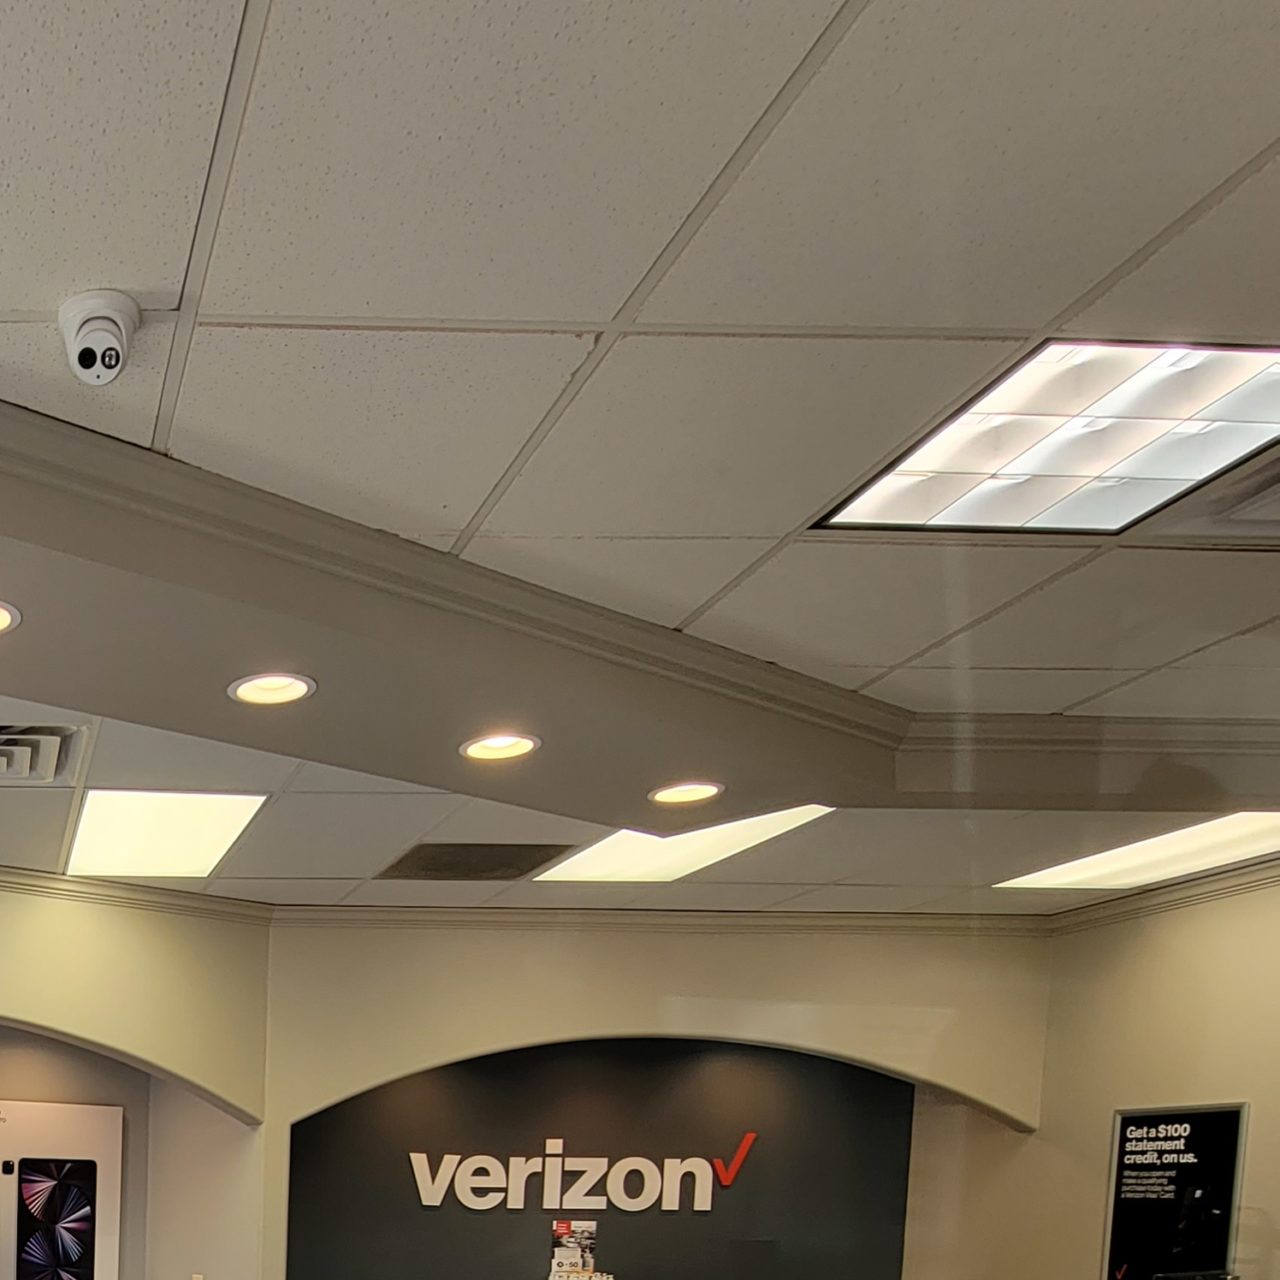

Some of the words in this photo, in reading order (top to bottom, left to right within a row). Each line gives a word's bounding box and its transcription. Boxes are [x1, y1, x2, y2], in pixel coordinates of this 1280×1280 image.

[1126, 1126, 1148, 1138] Get
[1148, 1128, 1156, 1137] a
[1157, 1123, 1191, 1138] $100
[1125, 1138, 1186, 1151] statement
[1124, 1151, 1161, 1166] credit,
[1162, 1154, 1178, 1163] on
[1179, 1153, 1198, 1163] us.
[409, 1138, 713, 1211] verizon
